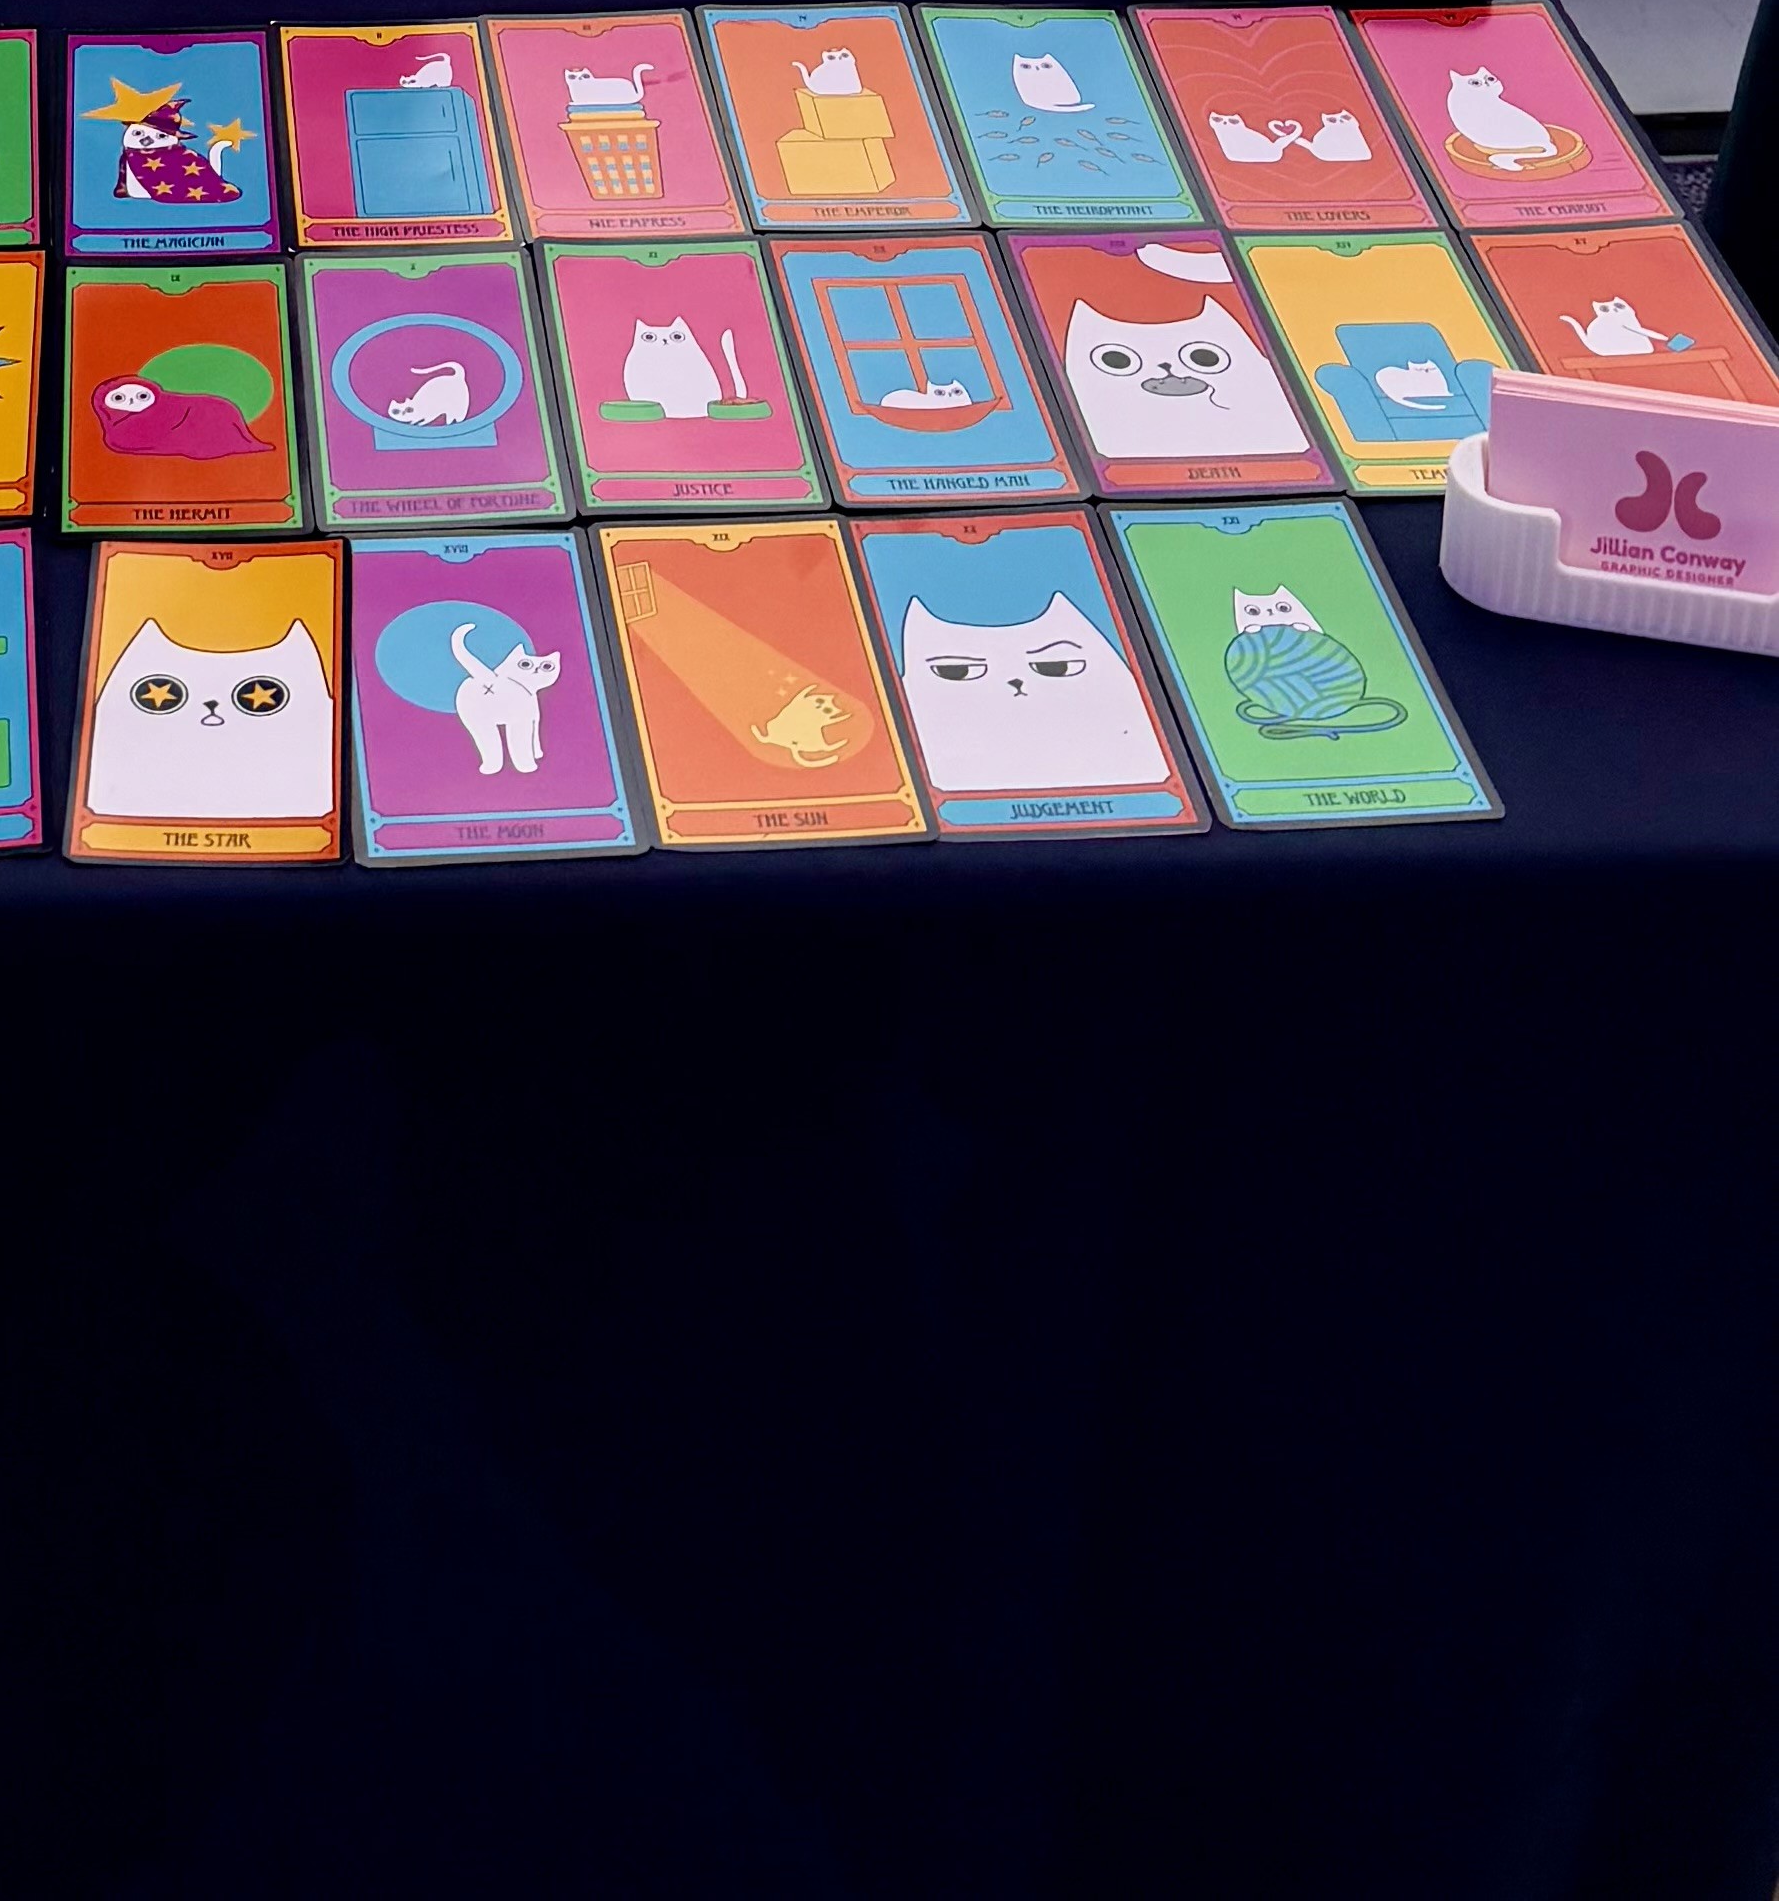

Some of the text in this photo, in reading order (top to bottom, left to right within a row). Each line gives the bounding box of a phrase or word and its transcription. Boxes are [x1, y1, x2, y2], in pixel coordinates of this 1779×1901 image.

[813, 206, 840, 218] THE
[1033, 205, 1063, 215] THE
[1287, 209, 1371, 222] THE LOVERS
[1514, 202, 1608, 218] THE CHARIOT
[333, 223, 480, 239] THE HIGH PRIESTESS
[121, 235, 226, 250] THE MAGICIAN
[1187, 466, 1242, 481] DEATH
[672, 482, 734, 497] JUSTICE
[889, 474, 1032, 491] THE HANGED MAN
[350, 498, 381, 514] THE
[388, 496, 442, 512] WHEEL
[447, 495, 466, 509] OF
[132, 506, 232, 522] THE HERMIT
[1590, 536, 1747, 577] Jillian Conway
[1601, 560, 1734, 586] GRAPHIC DESIGNER
[1303, 788, 1407, 807] THE WORLD
[1009, 799, 1114, 820] JUDGEMENT
[756, 811, 829, 828] THE SUN
[458, 823, 544, 840] THE MOON
[162, 832, 252, 849] THE STAR
